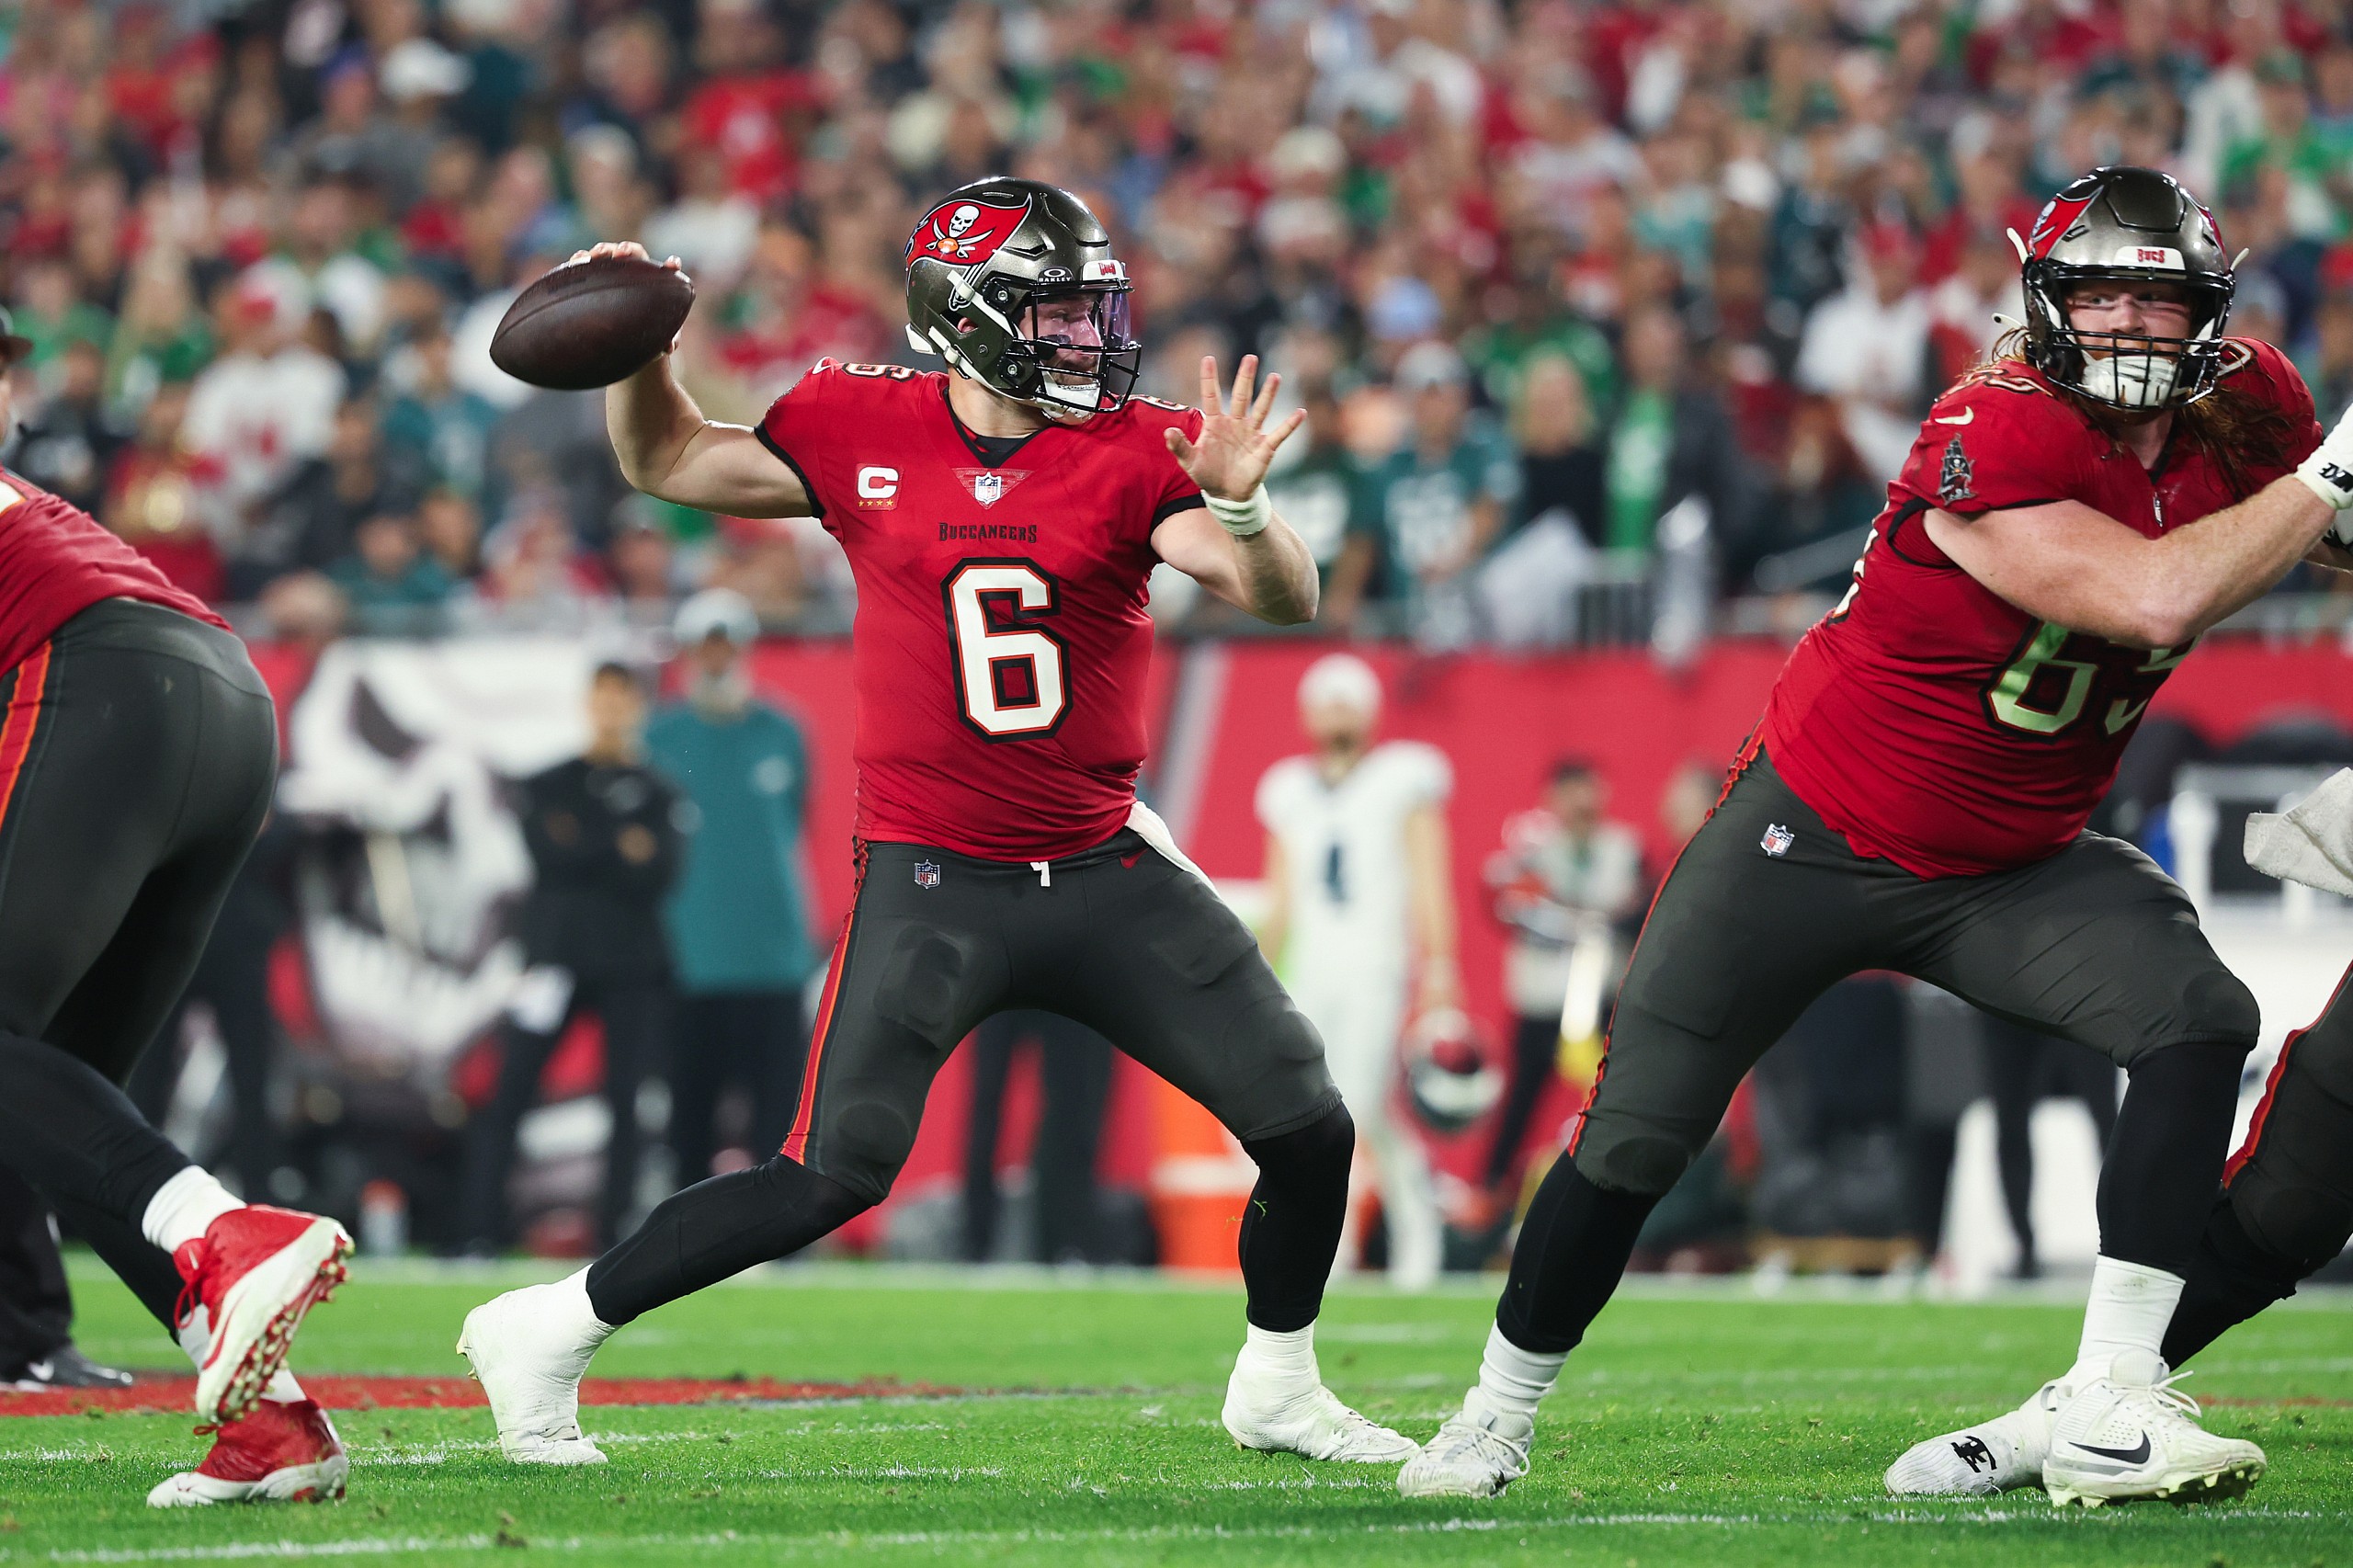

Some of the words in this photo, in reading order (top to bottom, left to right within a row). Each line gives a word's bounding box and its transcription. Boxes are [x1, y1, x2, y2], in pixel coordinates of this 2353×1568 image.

[857, 466, 900, 499] C
[938, 522, 1038, 543] BUCCANEERS
[940, 557, 1074, 744] 6
